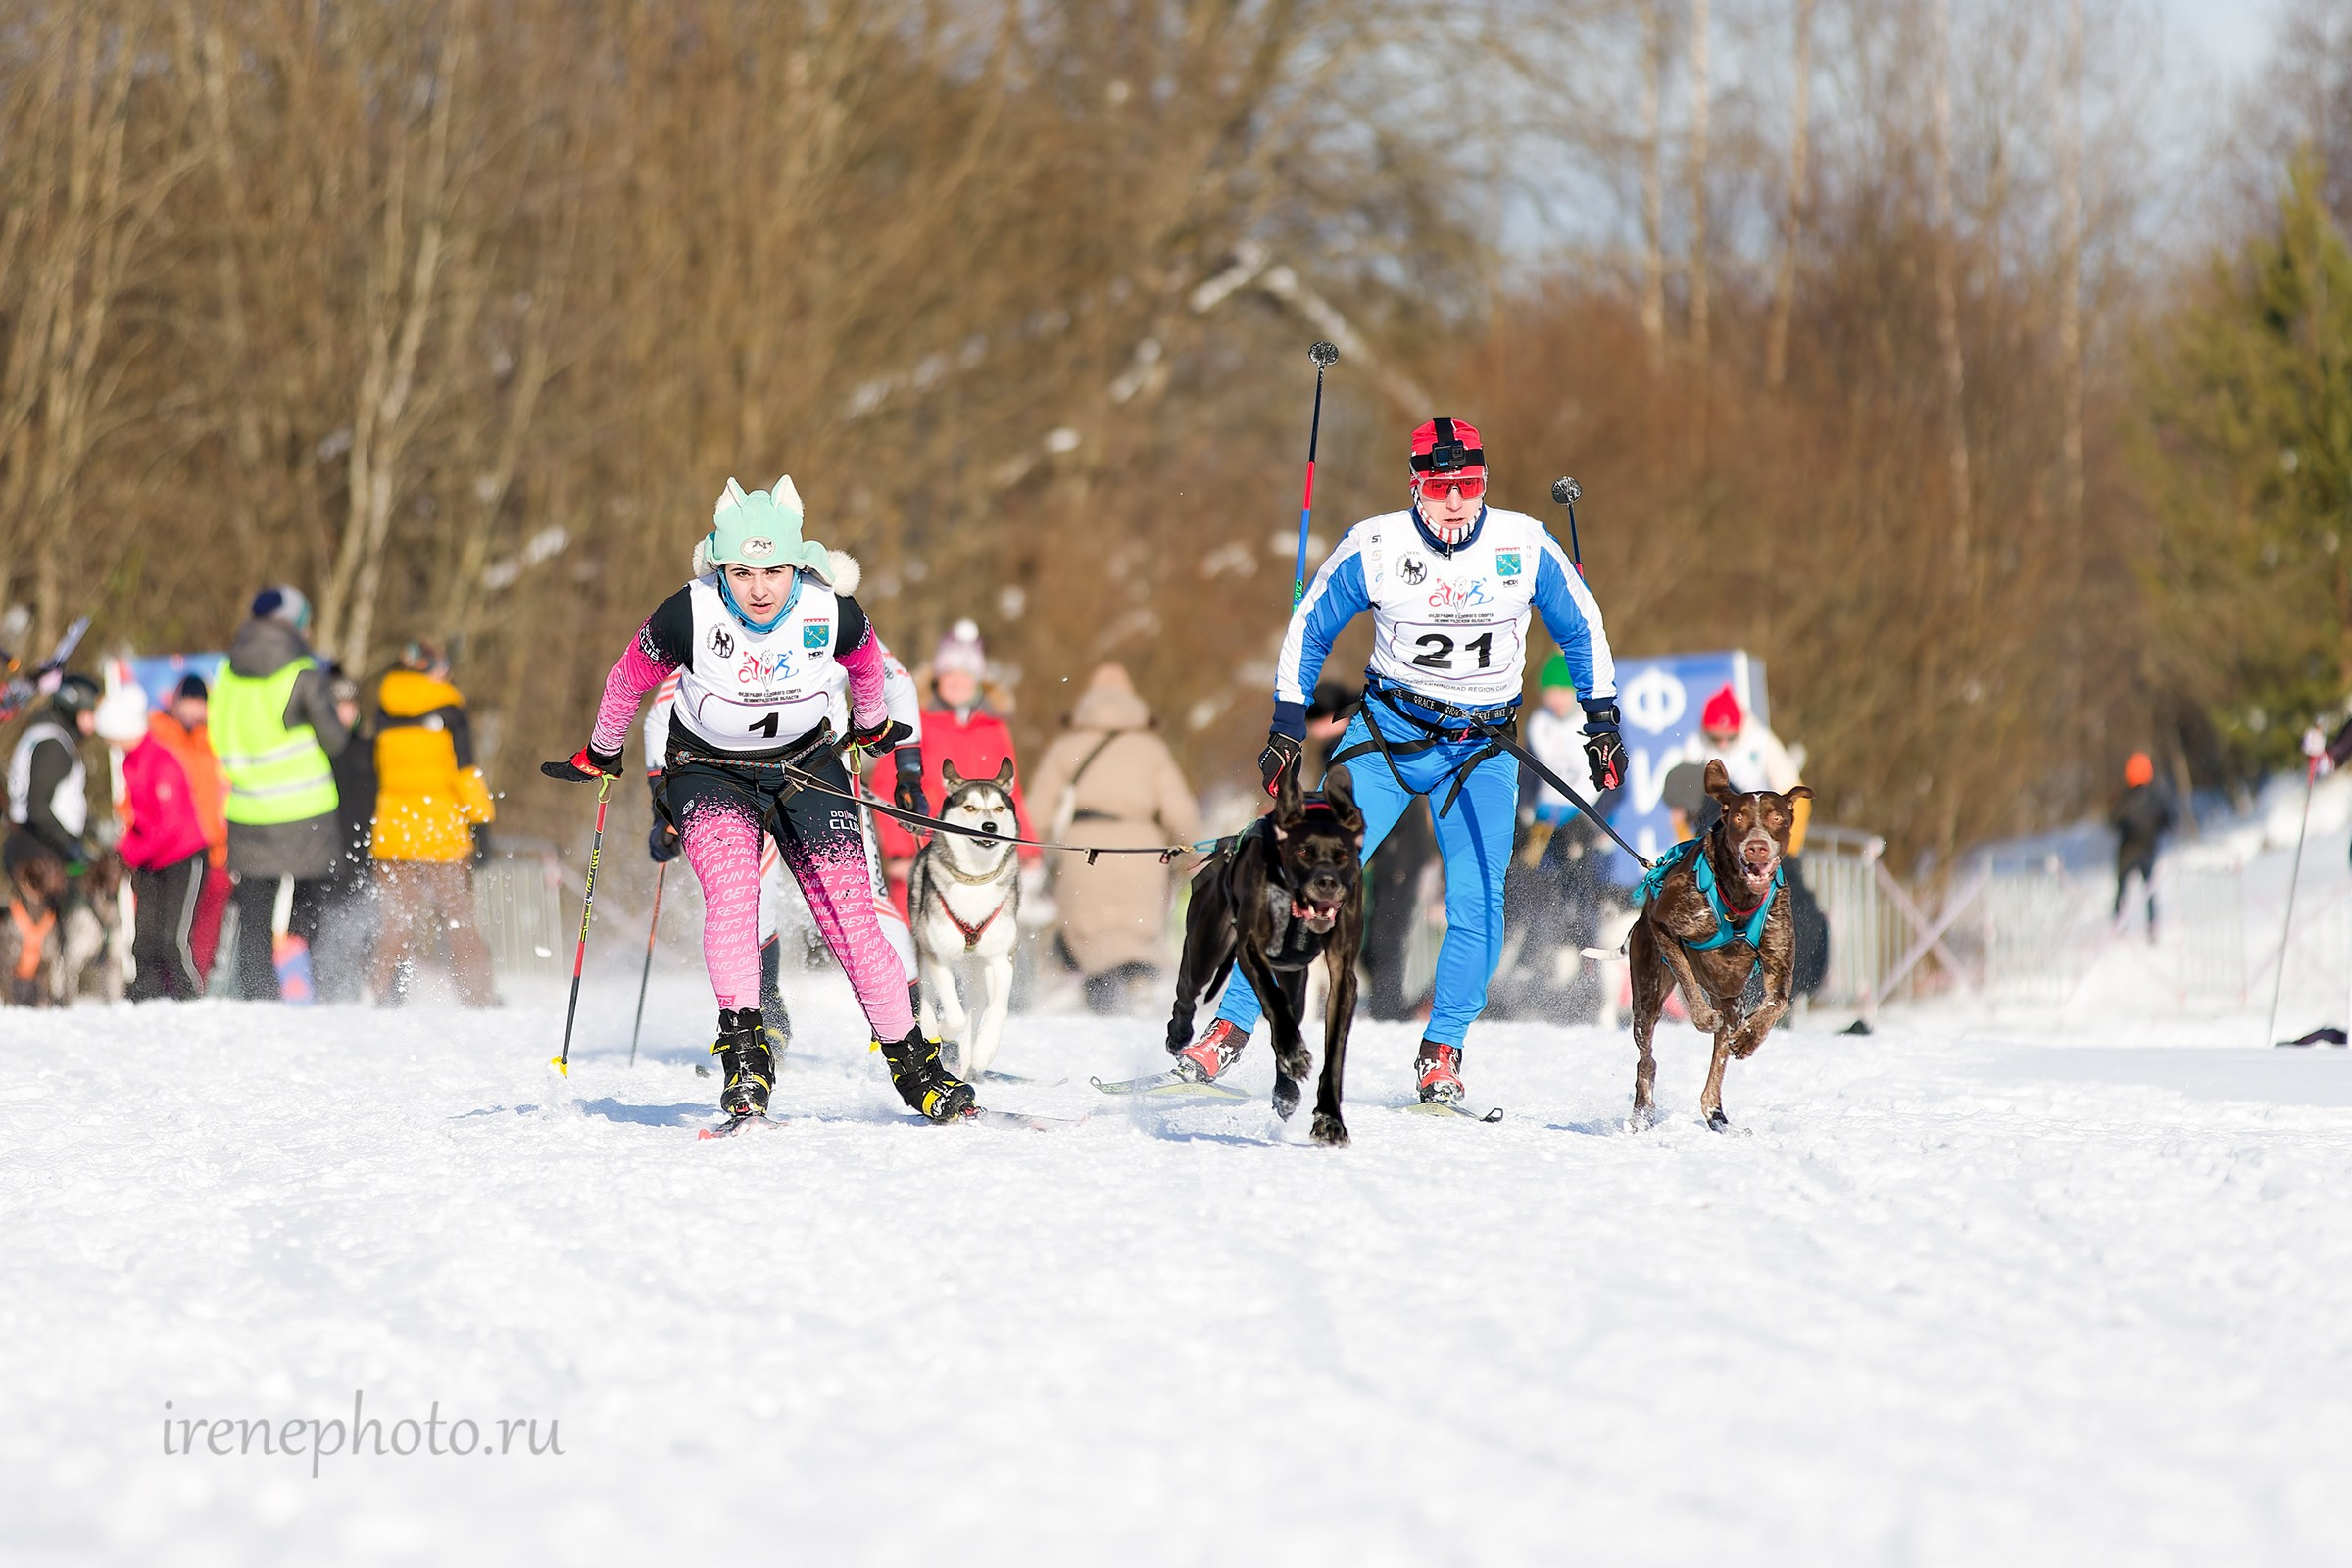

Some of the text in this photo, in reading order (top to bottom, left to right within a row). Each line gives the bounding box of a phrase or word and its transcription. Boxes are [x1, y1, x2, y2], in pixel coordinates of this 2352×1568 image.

[1412, 632, 1493, 669] 21
[748, 712, 779, 739] 1
[716, 870, 745, 887] FUN
[839, 874, 867, 886] FUN
[723, 885, 750, 902] GET
[830, 888, 861, 901] AND
[837, 902, 864, 914] GET
[715, 929, 751, 945] HAVE
[730, 942, 754, 957] FUN
